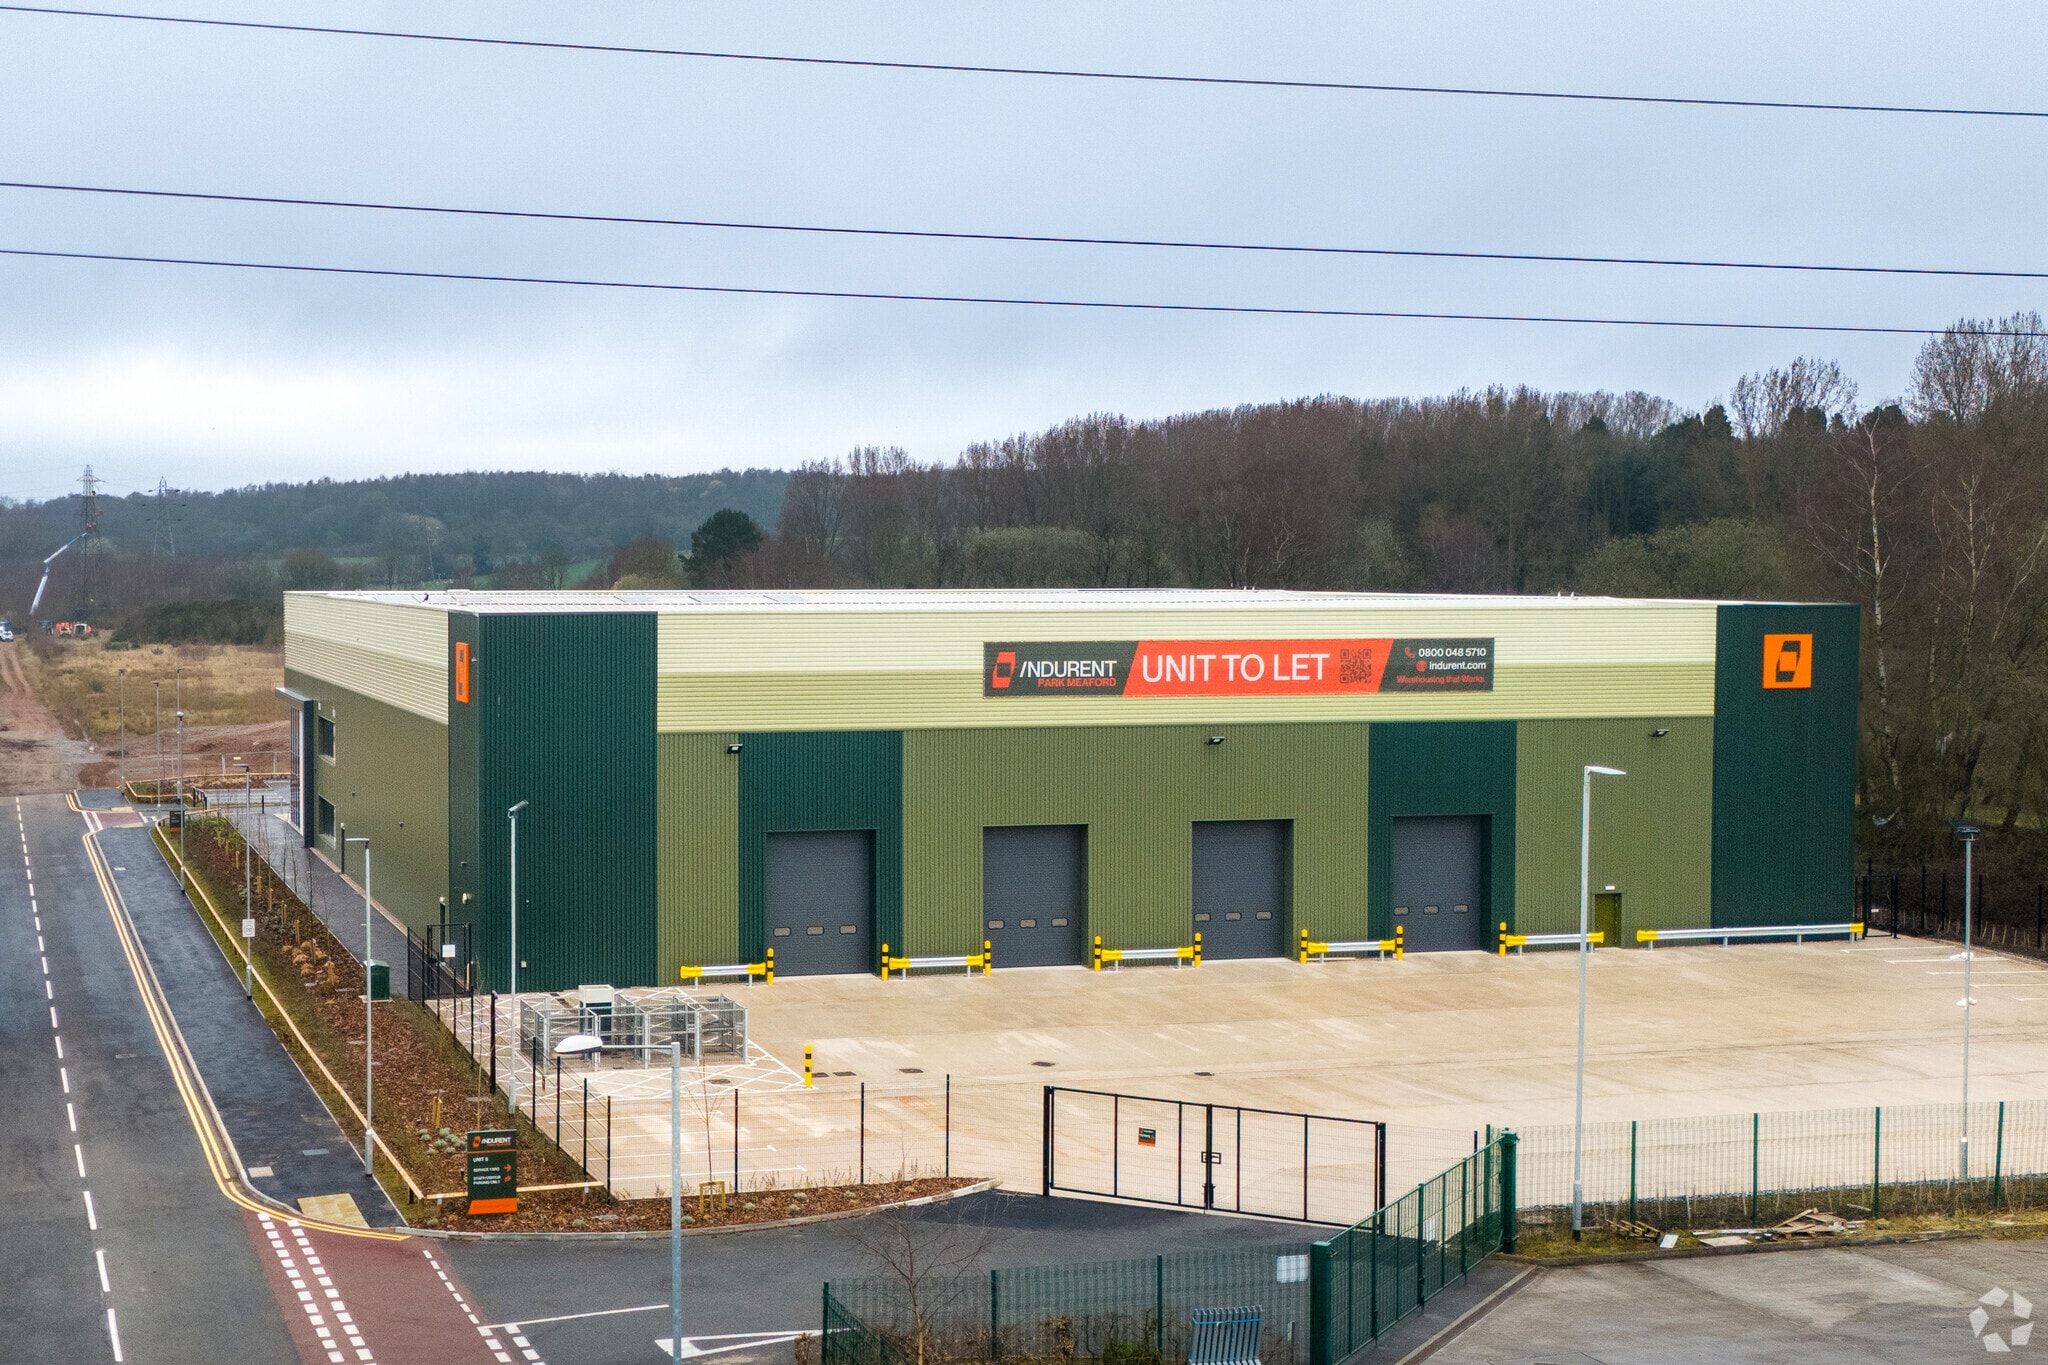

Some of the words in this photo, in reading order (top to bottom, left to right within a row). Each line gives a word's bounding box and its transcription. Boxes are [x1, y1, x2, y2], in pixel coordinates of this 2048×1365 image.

[1418, 648, 1443, 657] 0800
[1445, 648, 1464, 657] 048
[1465, 648, 1486, 656] 5710
[1142, 654, 1217, 683] UNIT
[1221, 653, 1265, 682] TO
[1273, 653, 1330, 681] LET
[1429, 661, 1486, 670] indurent.com
[1037, 679, 1065, 687] PARK
[1067, 678, 1117, 687] MEAFORD
[1396, 675, 1445, 684] Warehousing
[1446, 675, 1461, 683] that
